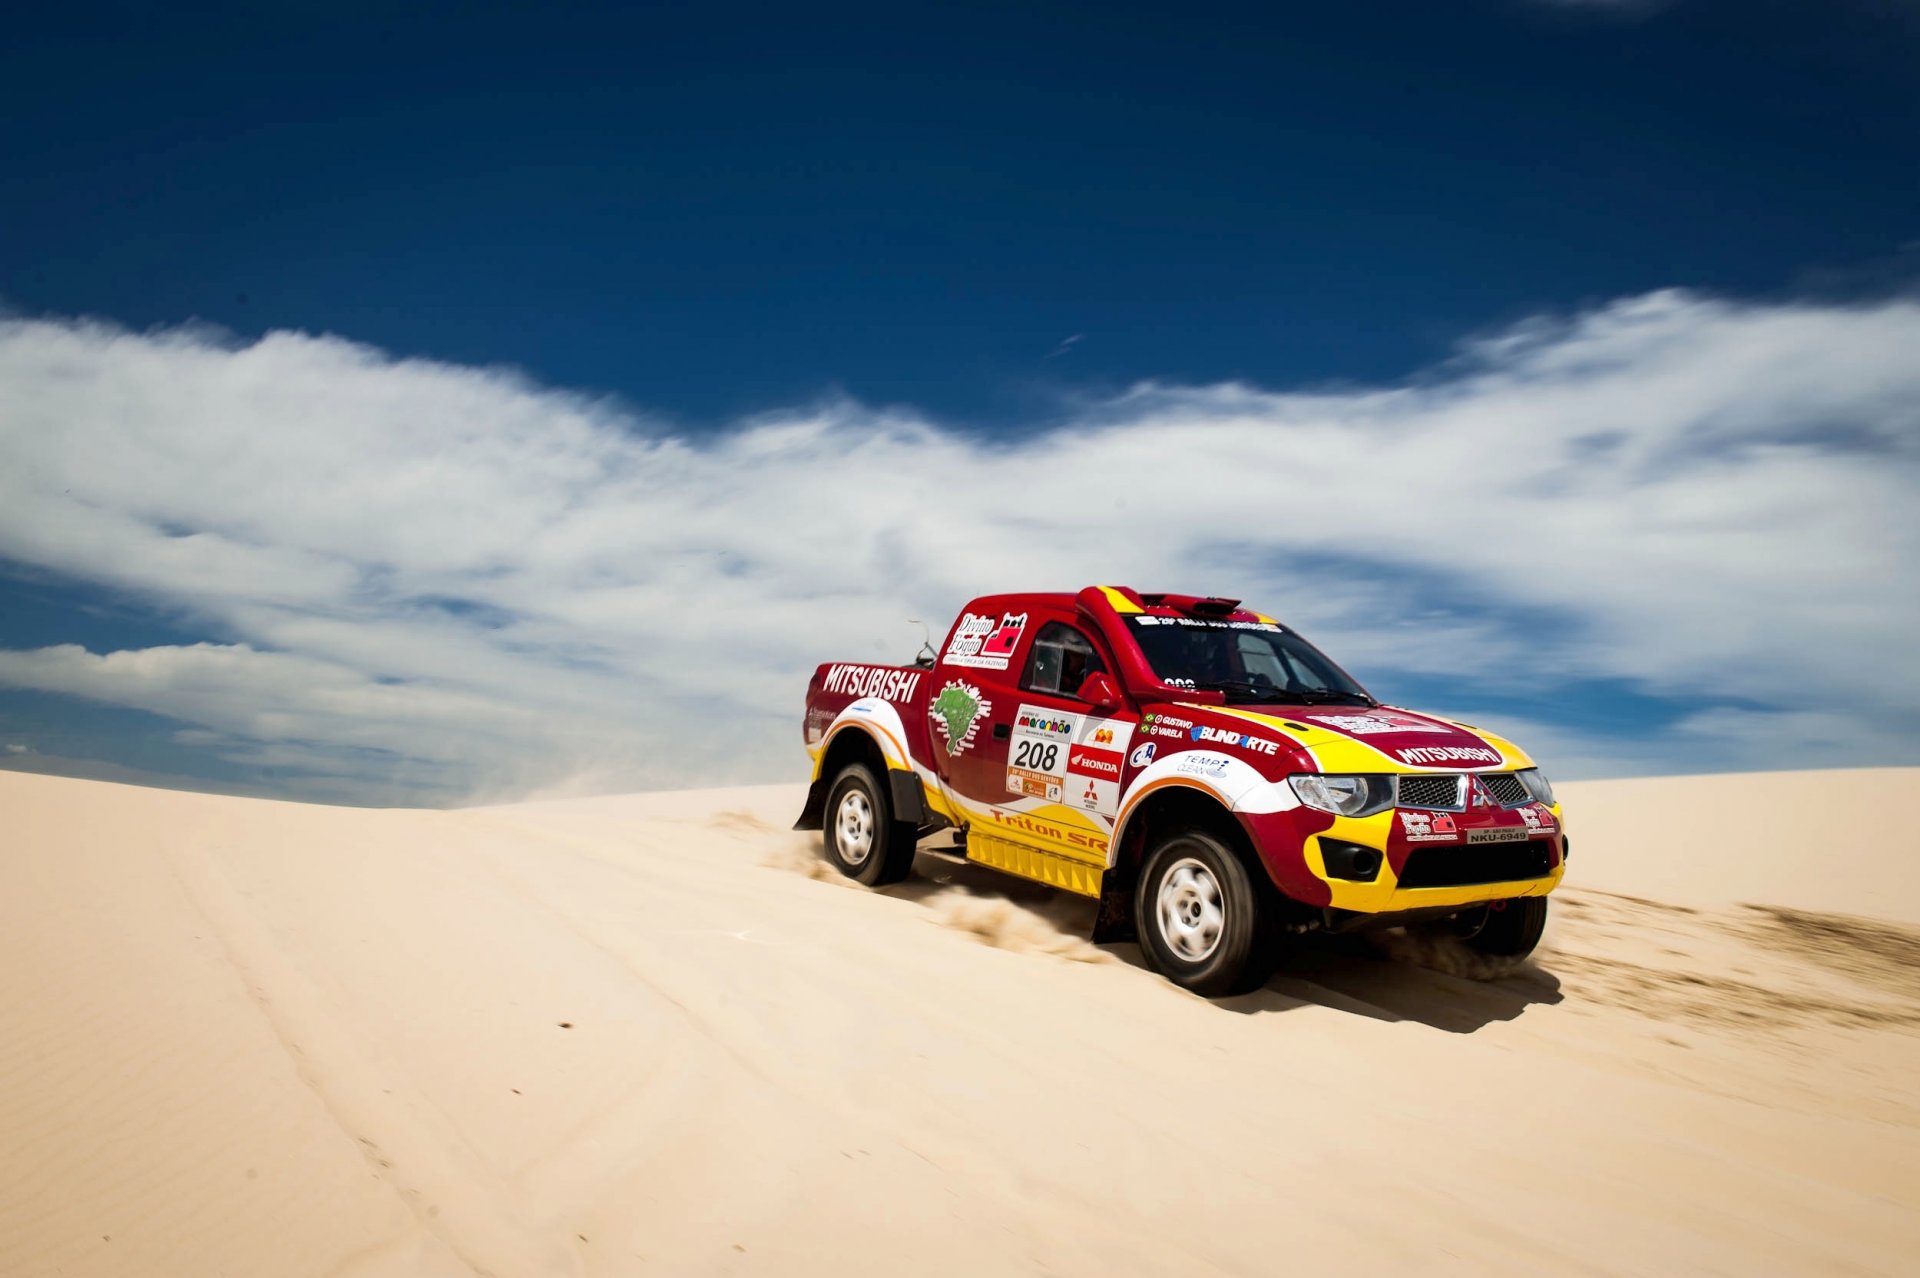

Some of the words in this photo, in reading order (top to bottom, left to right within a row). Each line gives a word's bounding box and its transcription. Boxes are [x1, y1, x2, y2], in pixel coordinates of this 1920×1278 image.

[823, 663, 921, 703] MITSUBISHI
[1162, 716, 1193, 729] GUSTAVO
[1158, 726, 1183, 739] VARELA
[1199, 725, 1280, 756] BLINDARTE
[1014, 740, 1059, 771] 208
[1395, 746, 1500, 764] MITSUBISHI
[1081, 758, 1118, 773] HONDA
[990, 809, 1062, 840] Triton
[1470, 832, 1526, 842] NKU-6949
